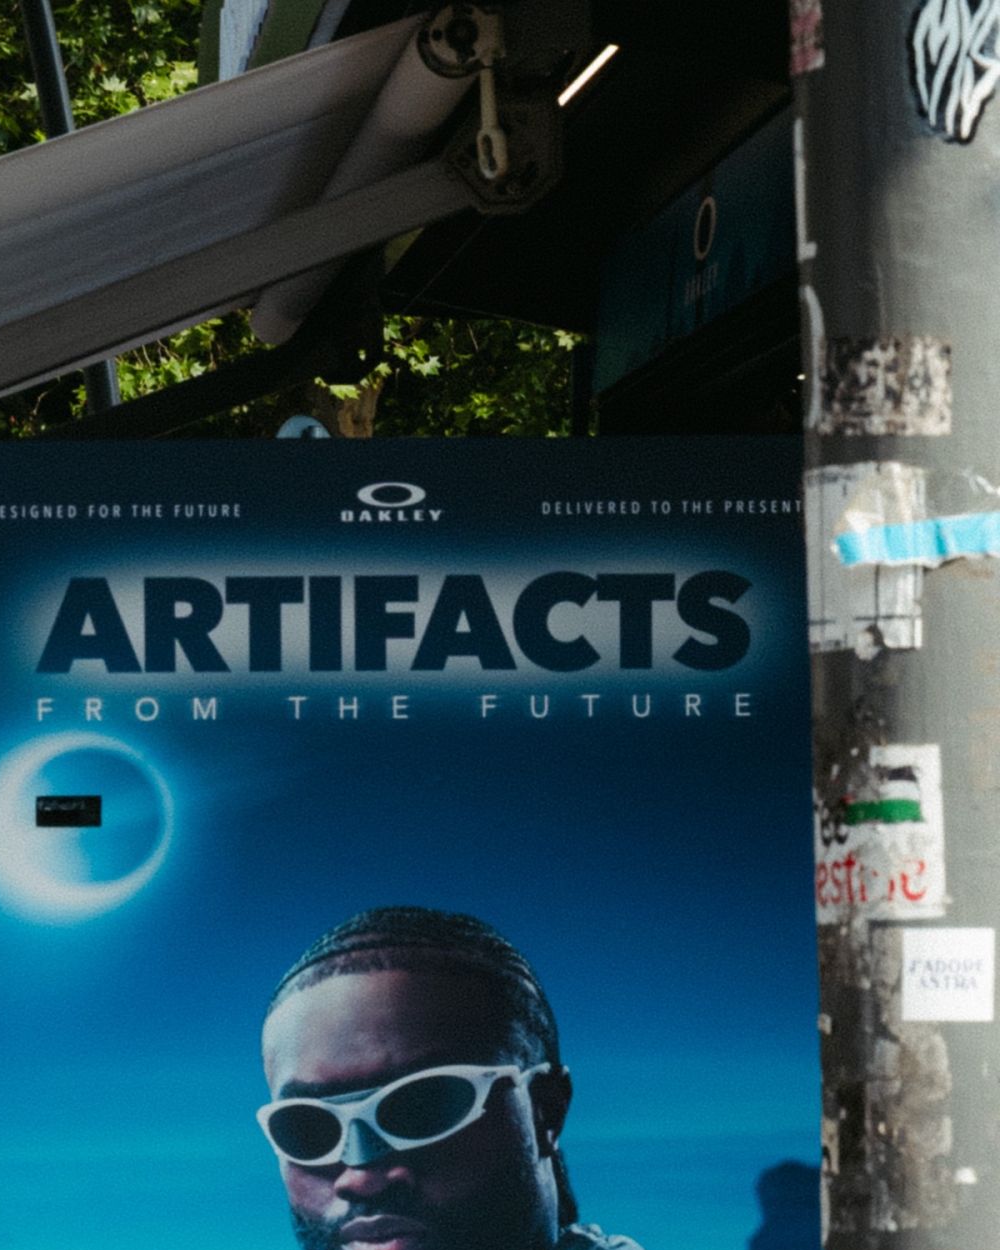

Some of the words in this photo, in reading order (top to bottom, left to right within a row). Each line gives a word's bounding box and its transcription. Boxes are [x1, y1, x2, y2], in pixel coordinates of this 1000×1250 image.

[88, 504, 121, 519] FOR
[132, 503, 163, 518] THE
[174, 503, 241, 518] FUTURE
[340, 509, 442, 522] OAKLEY
[541, 501, 641, 515] DELIVERED
[651, 501, 672, 515] TO
[682, 500, 713, 514] THE
[724, 500, 801, 514] PRESENT
[34, 570, 754, 674] ARTIFACTS
[36, 697, 217, 722] FROM
[288, 695, 410, 720] THE
[481, 693, 751, 719] FUTURE
